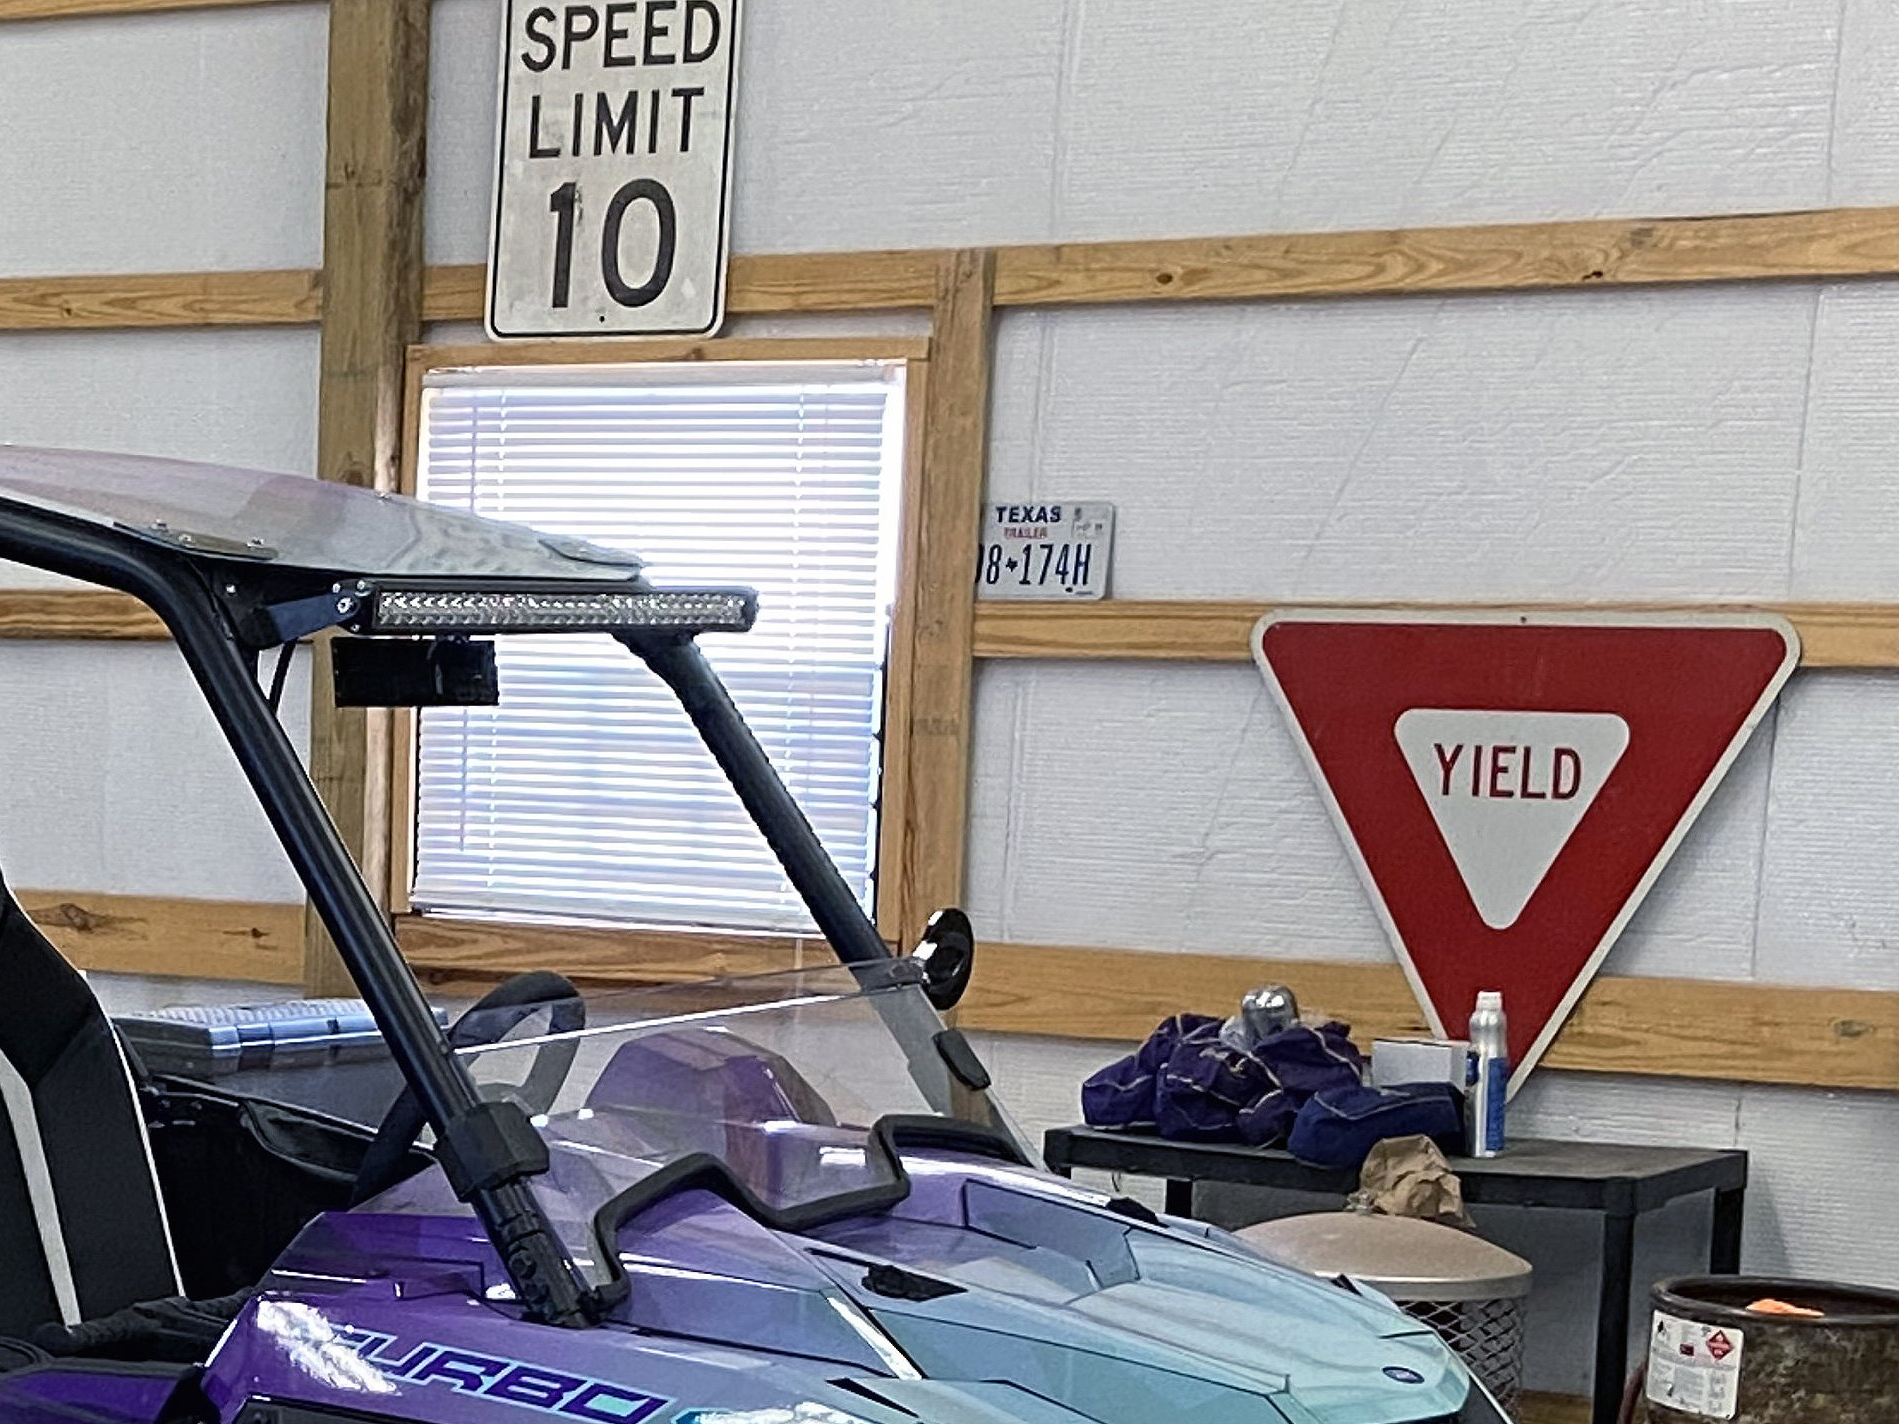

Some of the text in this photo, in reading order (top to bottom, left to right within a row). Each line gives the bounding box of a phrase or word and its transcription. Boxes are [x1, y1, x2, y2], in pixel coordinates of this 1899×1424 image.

[521, 0, 720, 72] SPEED
[528, 87, 704, 159] LIMIT
[550, 178, 677, 309] 10
[995, 506, 1061, 523] TEXAS
[1434, 743, 1581, 801] YIELD
